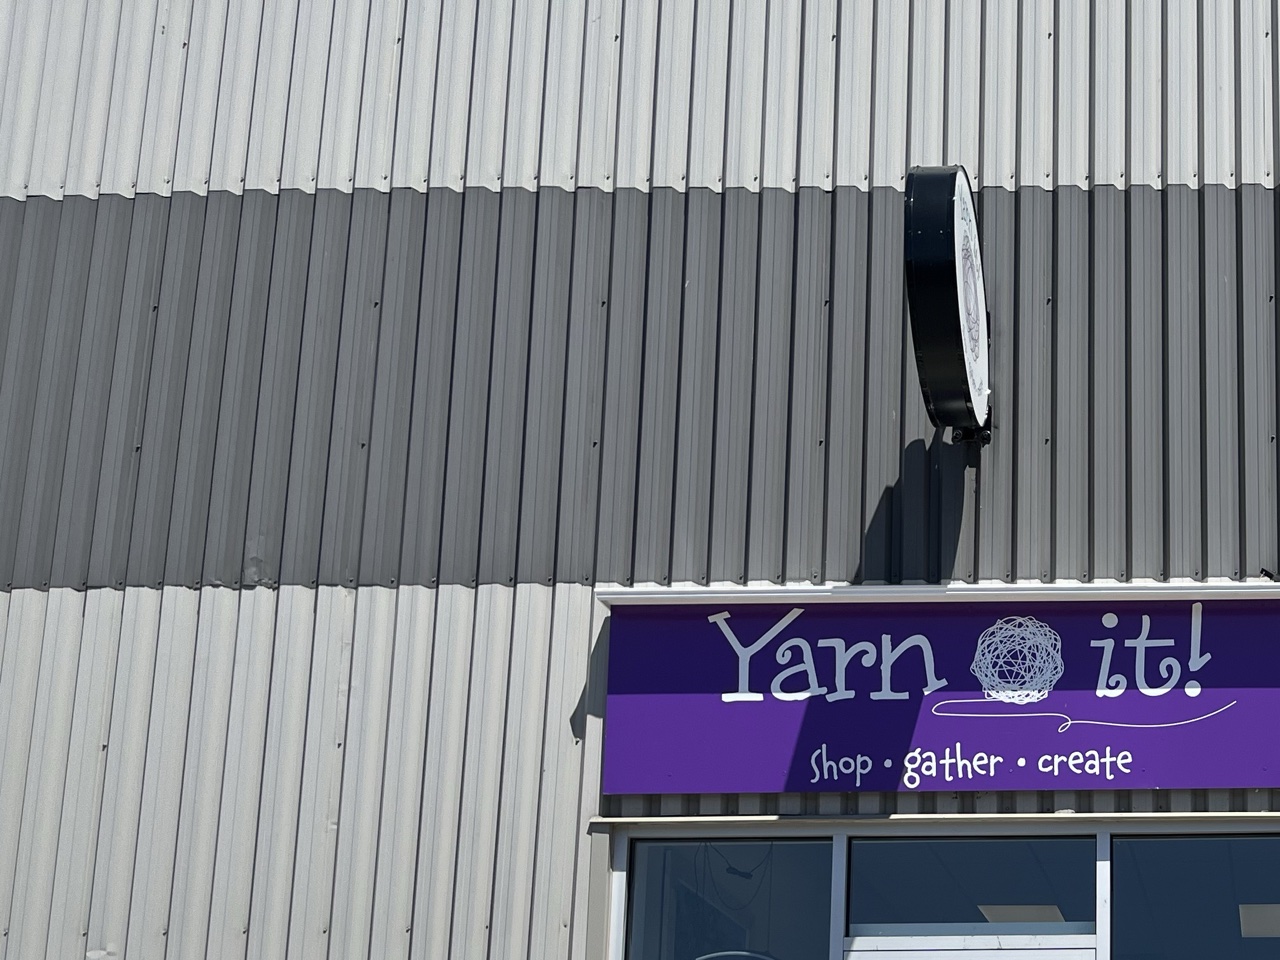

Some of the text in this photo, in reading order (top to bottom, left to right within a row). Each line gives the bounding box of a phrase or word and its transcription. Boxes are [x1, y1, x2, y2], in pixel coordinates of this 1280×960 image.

[707, 602, 1212, 702] Yarn it!
[811, 742, 1133, 789] shop gather create
